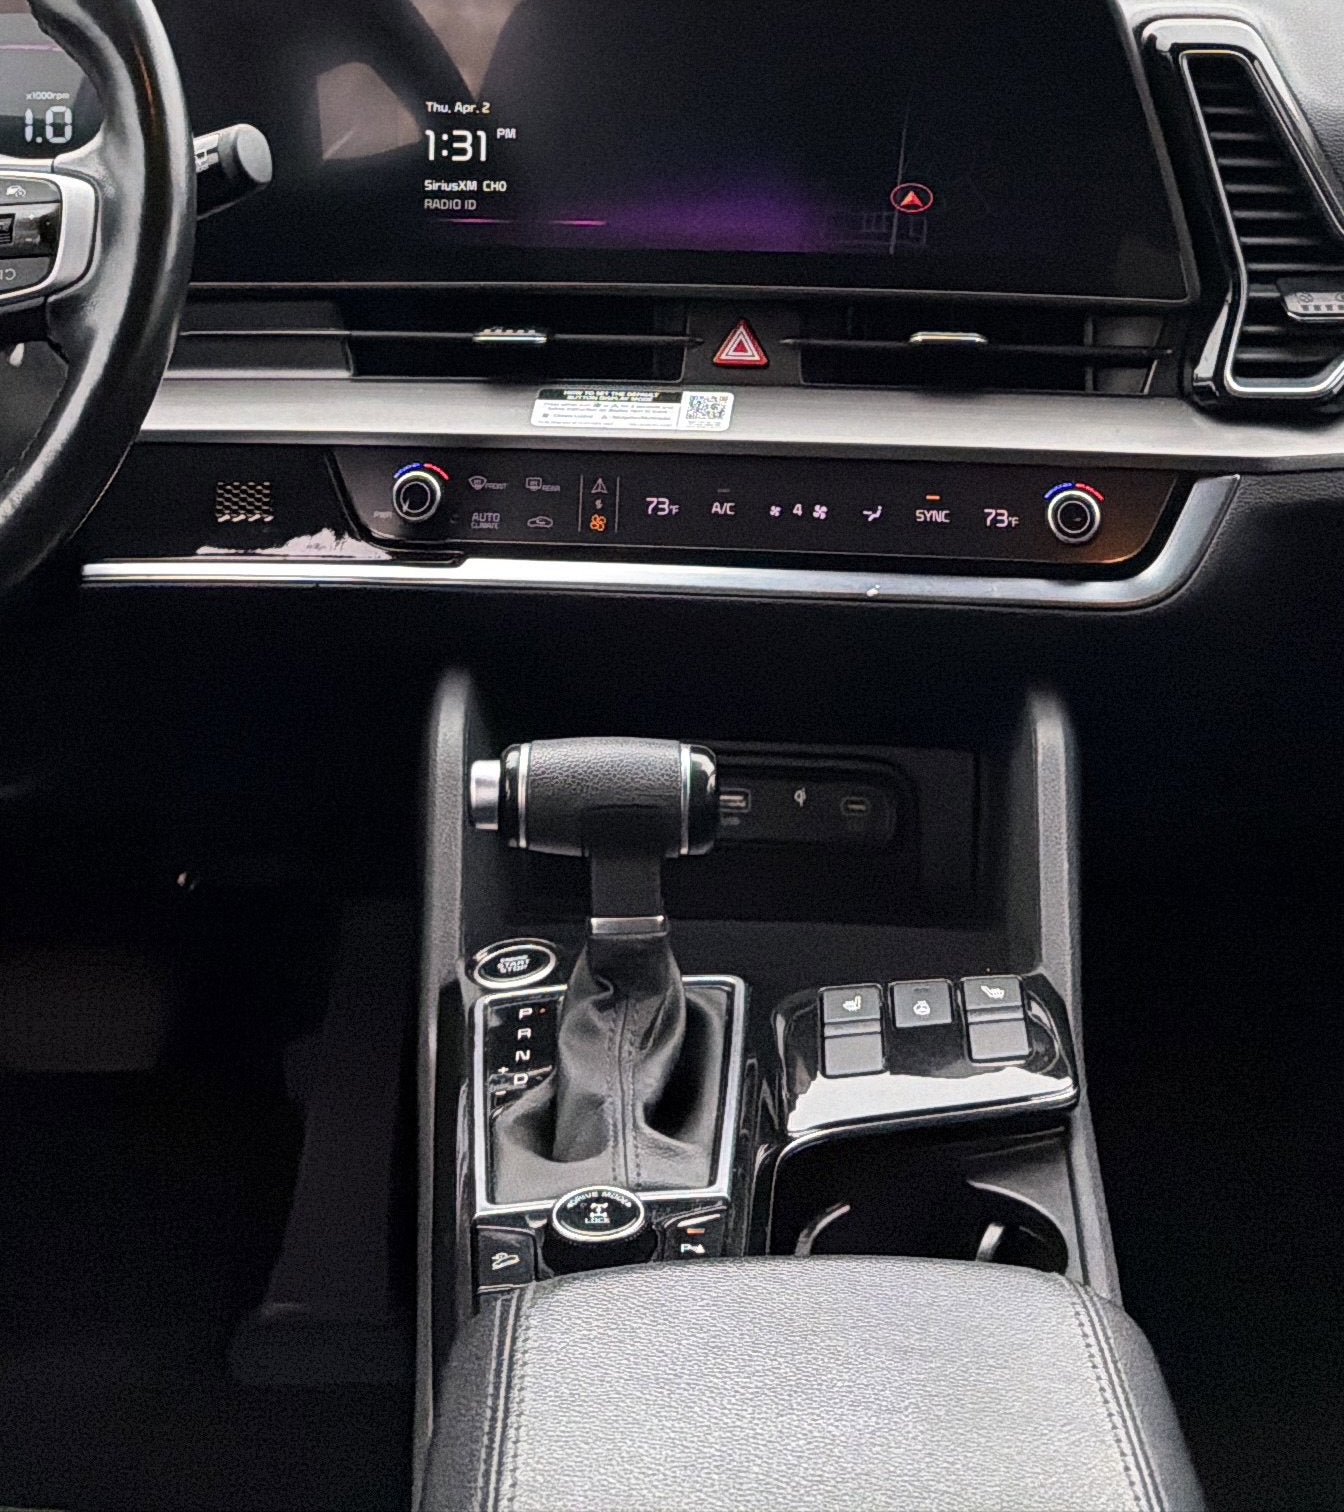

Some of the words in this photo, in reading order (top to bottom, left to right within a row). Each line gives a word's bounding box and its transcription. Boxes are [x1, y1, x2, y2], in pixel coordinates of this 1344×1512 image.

[482, 102, 491, 114] 2
[24, 105, 73, 144] 1.0
[424, 129, 487, 162] 1:31
[496, 128, 517, 139] PM
[424, 179, 478, 191] SiriusXM
[424, 199, 462, 210] RADIO
[464, 199, 477, 210] ID
[711, 502, 736, 515] A/C
[792, 503, 803, 517] 4
[471, 512, 501, 522] AUTO
[915, 508, 951, 524] SYNC
[518, 1008, 533, 1020] P
[515, 1050, 531, 1062] N
[513, 1073, 529, 1085] D
